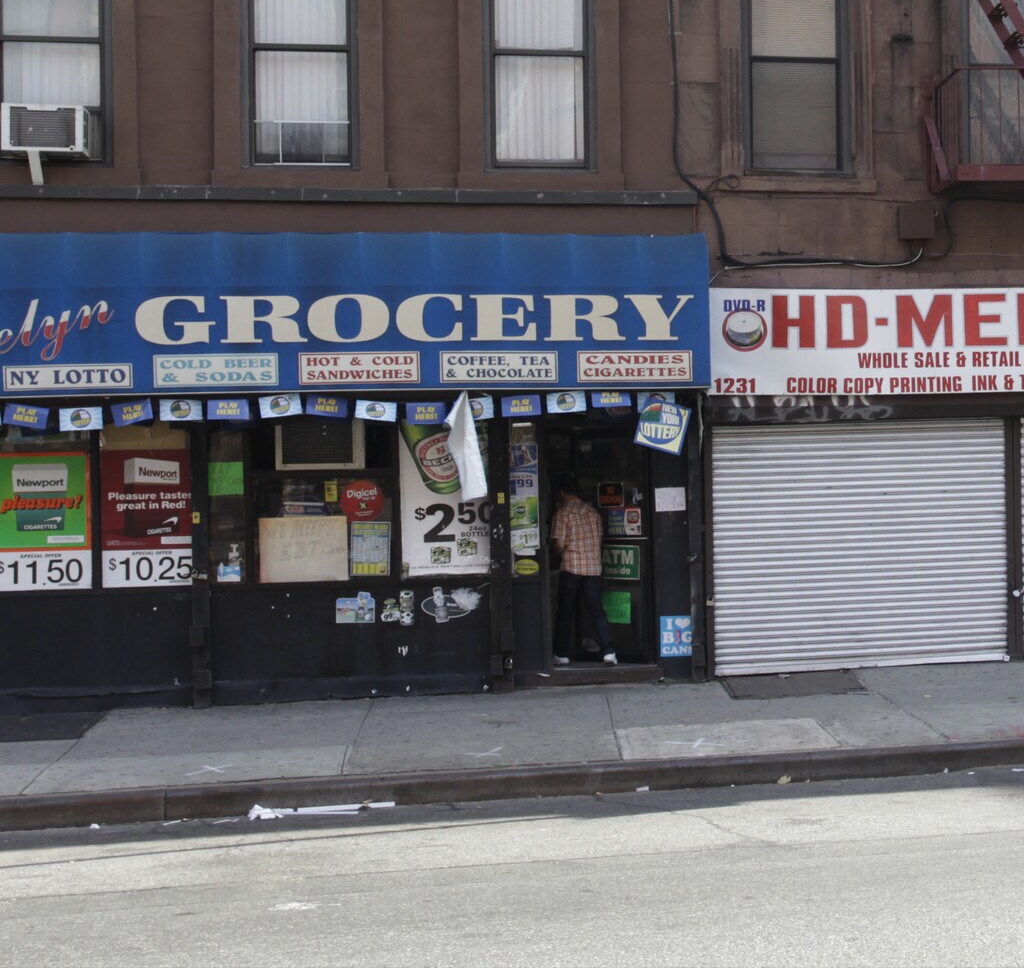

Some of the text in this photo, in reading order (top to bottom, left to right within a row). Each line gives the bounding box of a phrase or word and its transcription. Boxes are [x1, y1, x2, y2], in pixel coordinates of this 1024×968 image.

[723, 299, 766, 312] DVD-R
[135, 293, 694, 346] GROCERY
[159, 357, 272, 369] COLD BEER
[306, 356, 415, 367] HOT & COLD
[446, 355, 550, 367] COFFEE, TEA
[585, 354, 684, 365] CANDIES
[858, 352, 908, 369] WHOLE
[914, 351, 950, 368] SALE
[957, 350, 966, 367] &
[972, 350, 1021, 367] RETAIL
[10, 368, 126, 386] NY LOTTO
[162, 371, 273, 382] & SODAS
[306, 369, 413, 380] SANDWICHES
[446, 368, 553, 379] & CHOCOLATE
[583, 366, 687, 378] CIGARETTES
[714, 378, 756, 393] 1231
[787, 377, 837, 393] COLOR
[843, 377, 884, 394] COPY
[890, 375, 962, 392] PRINTING
[972, 374, 1002, 391] INK
[1004, 374, 1014, 390] &
[16, 407, 37, 415] PLAY
[122, 404, 142, 414] PLAY
[315, 404, 338, 413] HERE!
[416, 406, 436, 414] PLAY
[662, 403, 678, 414] NEW
[12, 413, 38, 424] HERE!
[121, 410, 144, 422] HERE!
[415, 413, 438, 421] HERE!
[662, 412, 681, 425] YORK
[640, 421, 681, 440] LOTTERY
[138, 467, 178, 479] Newport
[16, 478, 64, 488] Newport
[108, 491, 157, 501] Pleasure
[346, 487, 378, 500] Digicel
[0, 494, 84, 514] pleasure!
[116, 500, 186, 512] great in Red!
[147, 527, 172, 535] CIGARETTES
[602, 549, 634, 565] ATM
